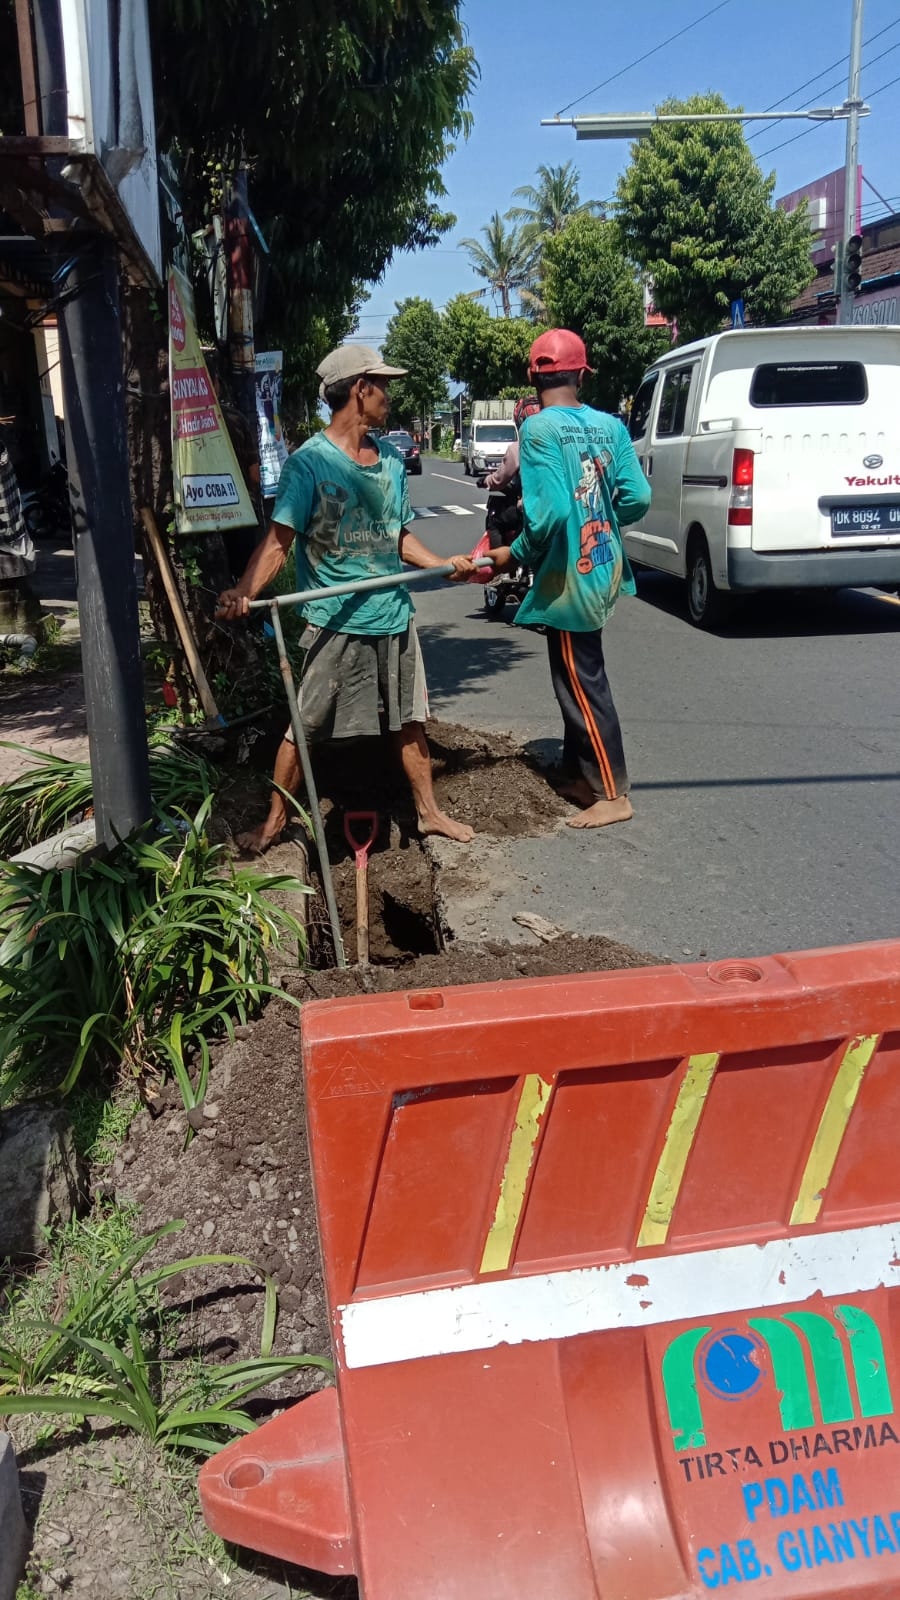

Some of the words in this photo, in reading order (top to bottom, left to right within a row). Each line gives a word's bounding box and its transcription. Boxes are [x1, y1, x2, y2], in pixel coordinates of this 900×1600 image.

[185, 484, 204, 502] Ayo
[844, 474, 900, 486] Yakult
[836, 511, 850, 525] DK
[852, 510, 881, 523] 8094
[679, 1446, 763, 1482] TIRTA
[768, 1422, 900, 1465] DHARMA
[741, 1467, 844, 1523] PDAM
[696, 1539, 773, 1589] CAB.
